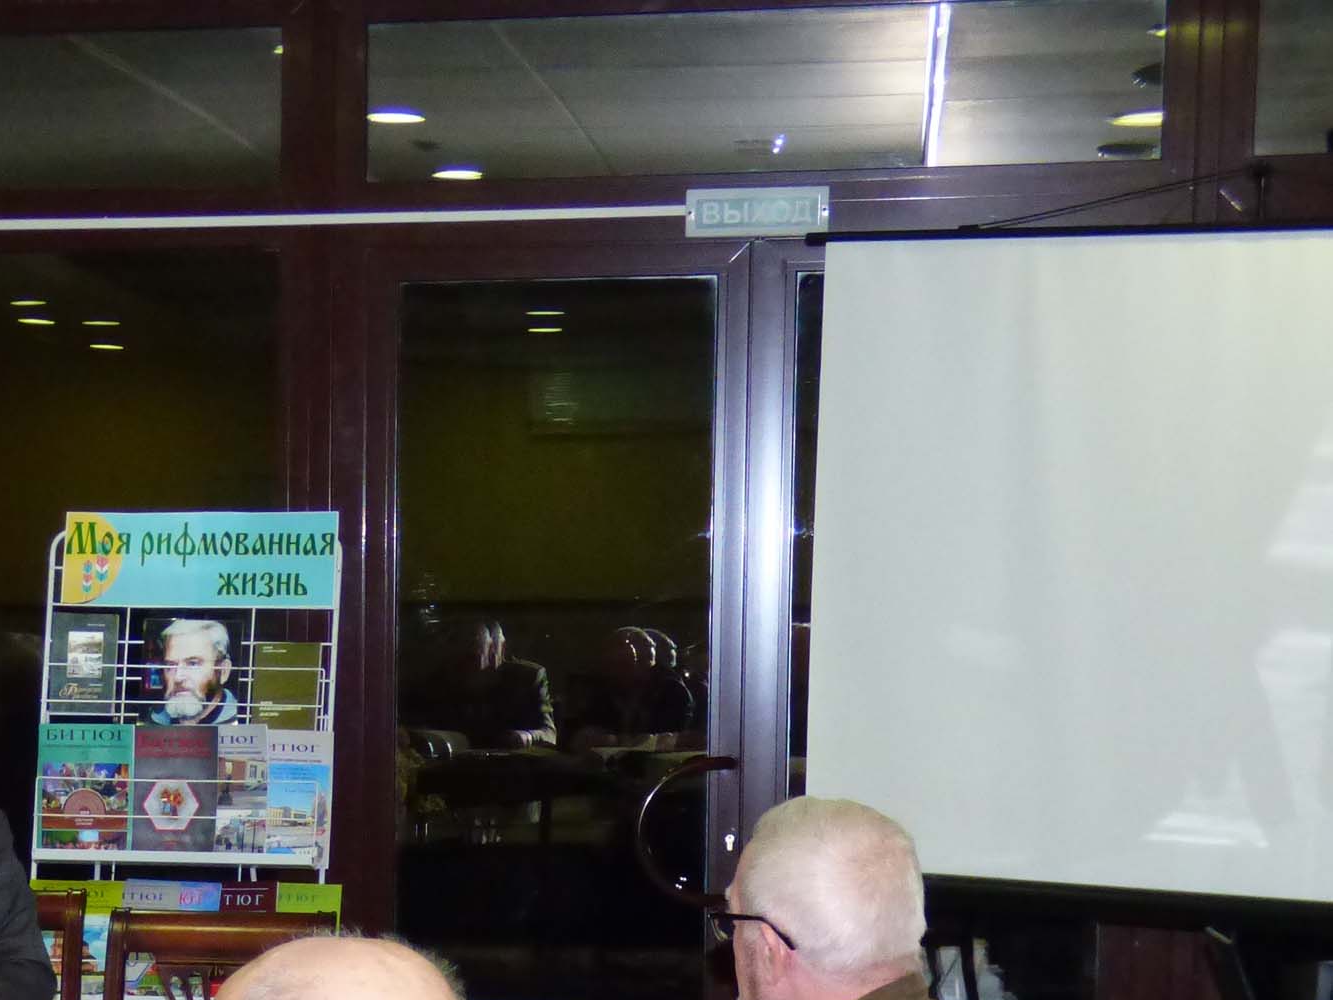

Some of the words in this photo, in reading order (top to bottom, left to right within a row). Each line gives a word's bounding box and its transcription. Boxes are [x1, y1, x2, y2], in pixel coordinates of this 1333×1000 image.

[702, 201, 812, 224] ВЫХОД
[66, 521, 131, 555] Моя
[141, 522, 336, 567] рифмованная
[217, 572, 308, 598] жизнь
